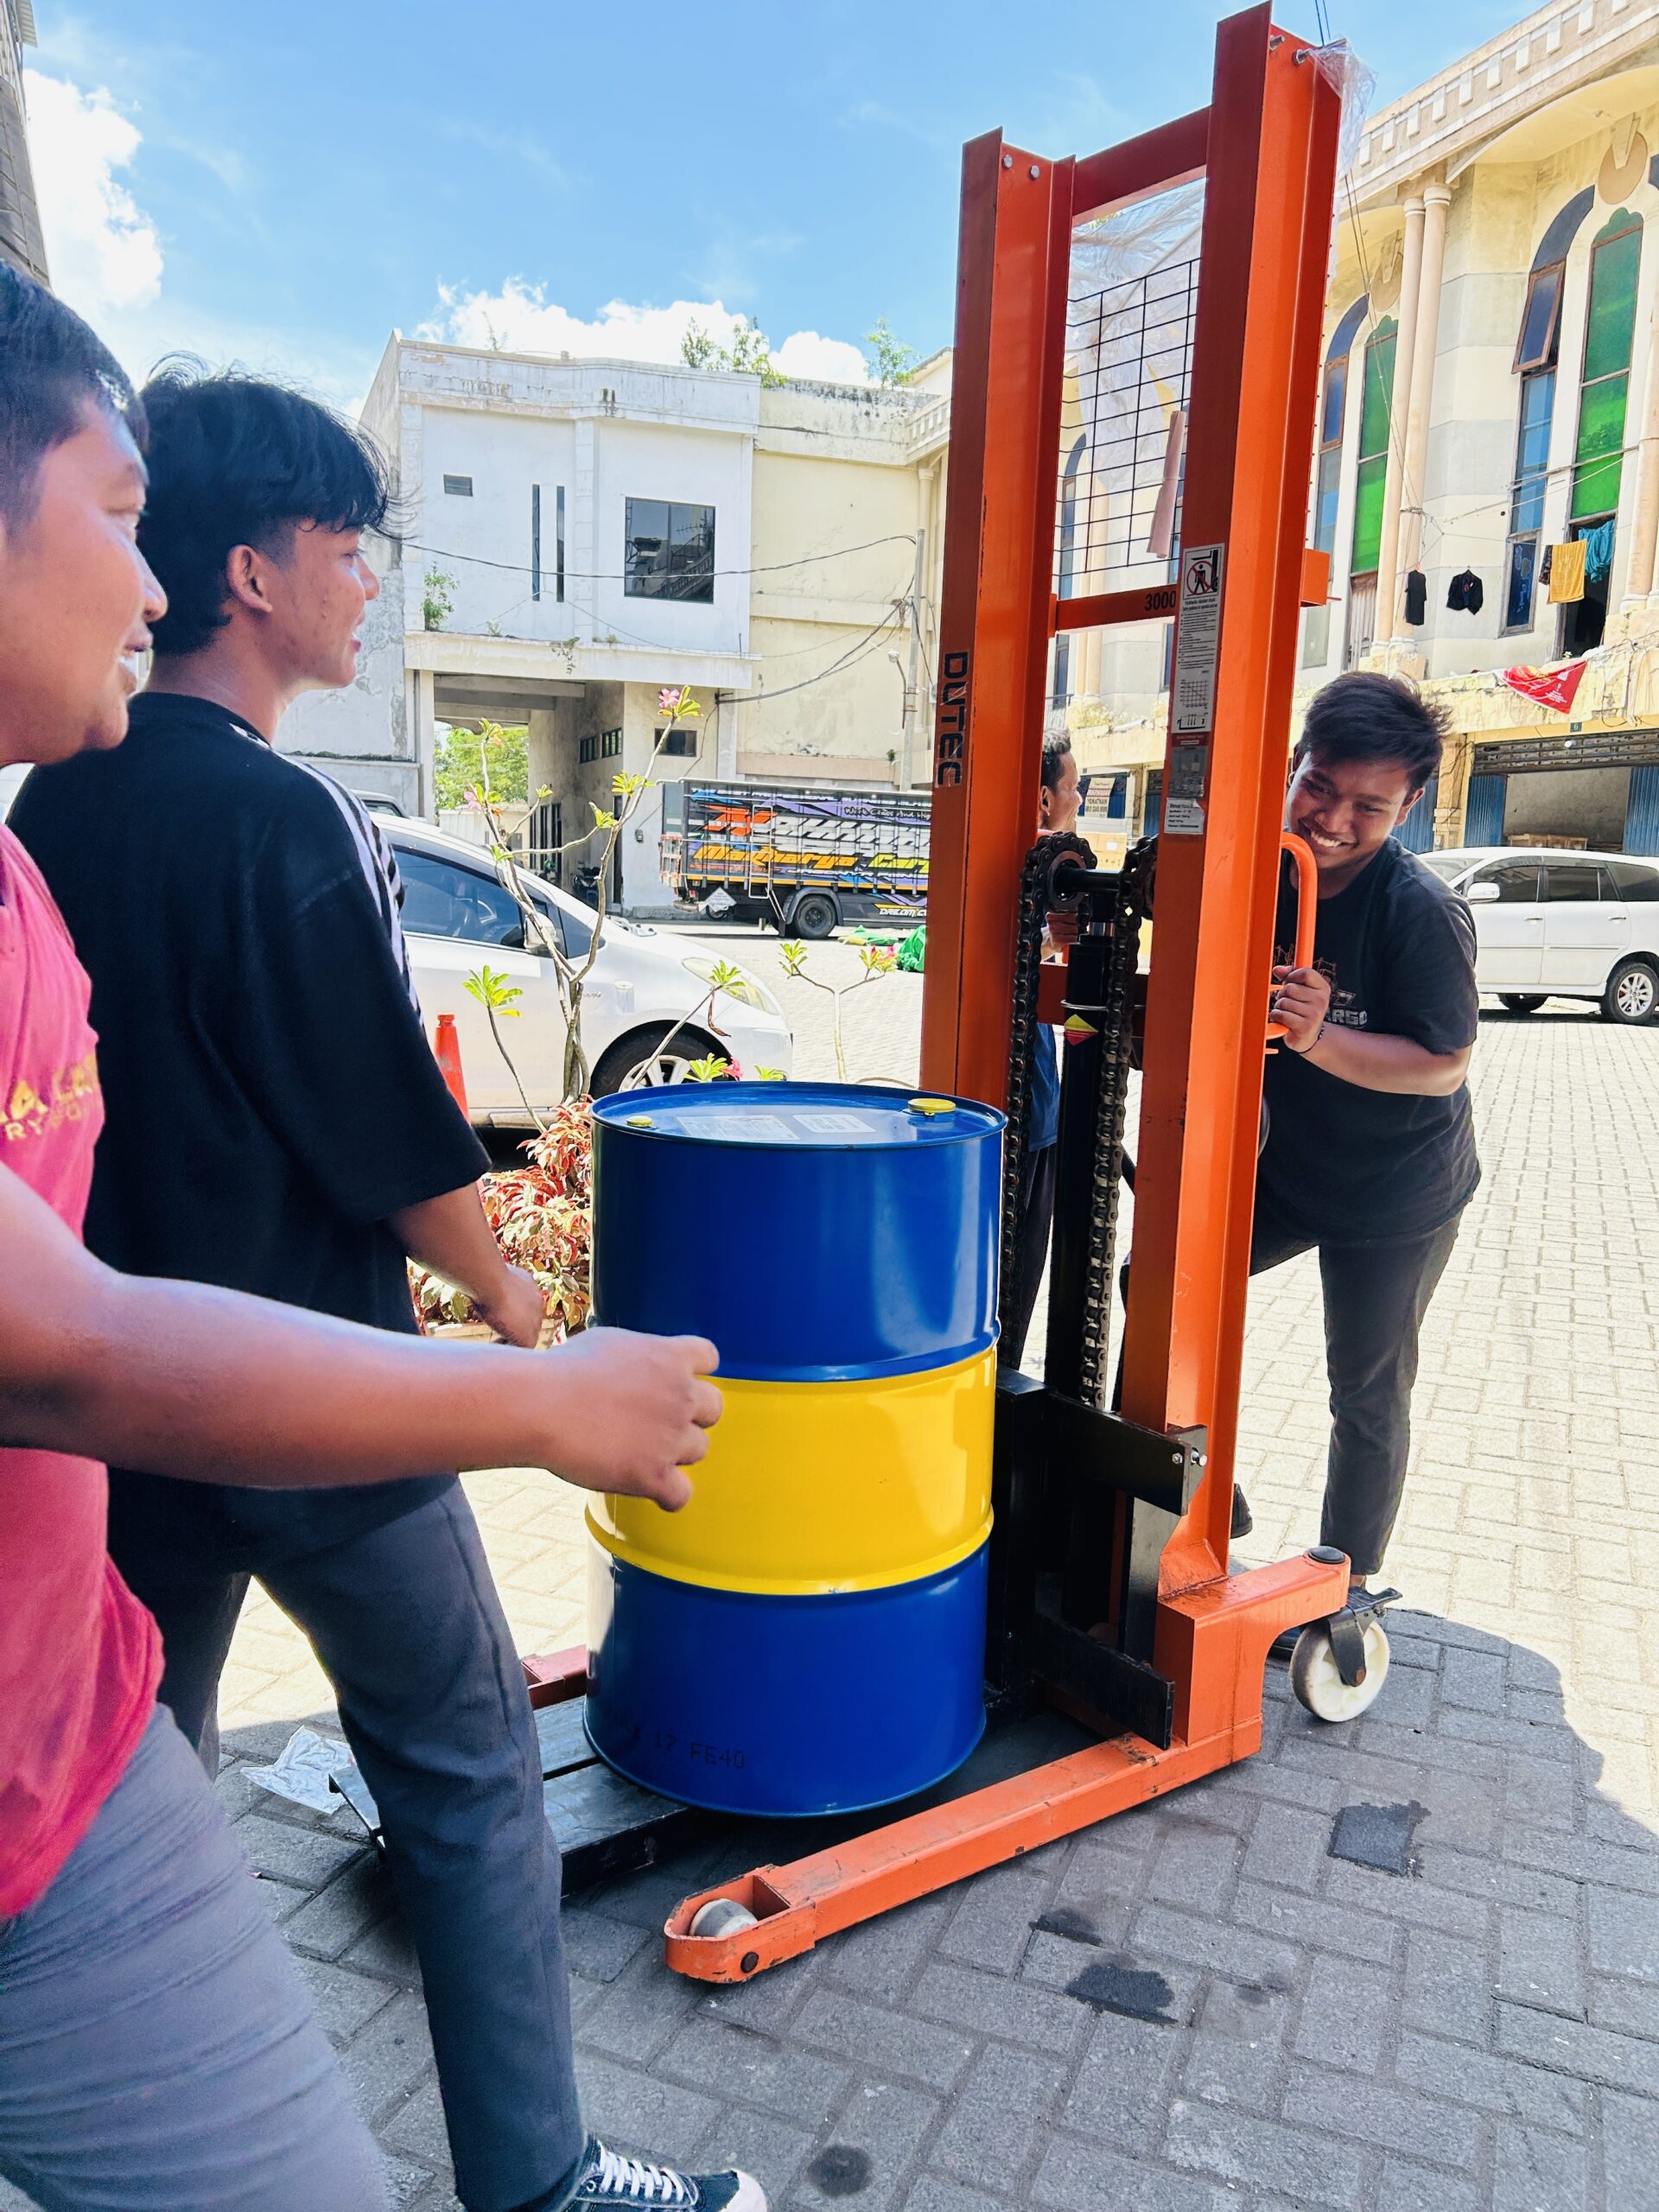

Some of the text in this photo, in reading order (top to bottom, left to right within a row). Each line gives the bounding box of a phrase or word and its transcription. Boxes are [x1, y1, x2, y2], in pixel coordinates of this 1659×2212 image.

[1144, 590, 1177, 611] 3000
[938, 652, 969, 785] DUTEC
[690, 1741, 746, 1770] FE40
